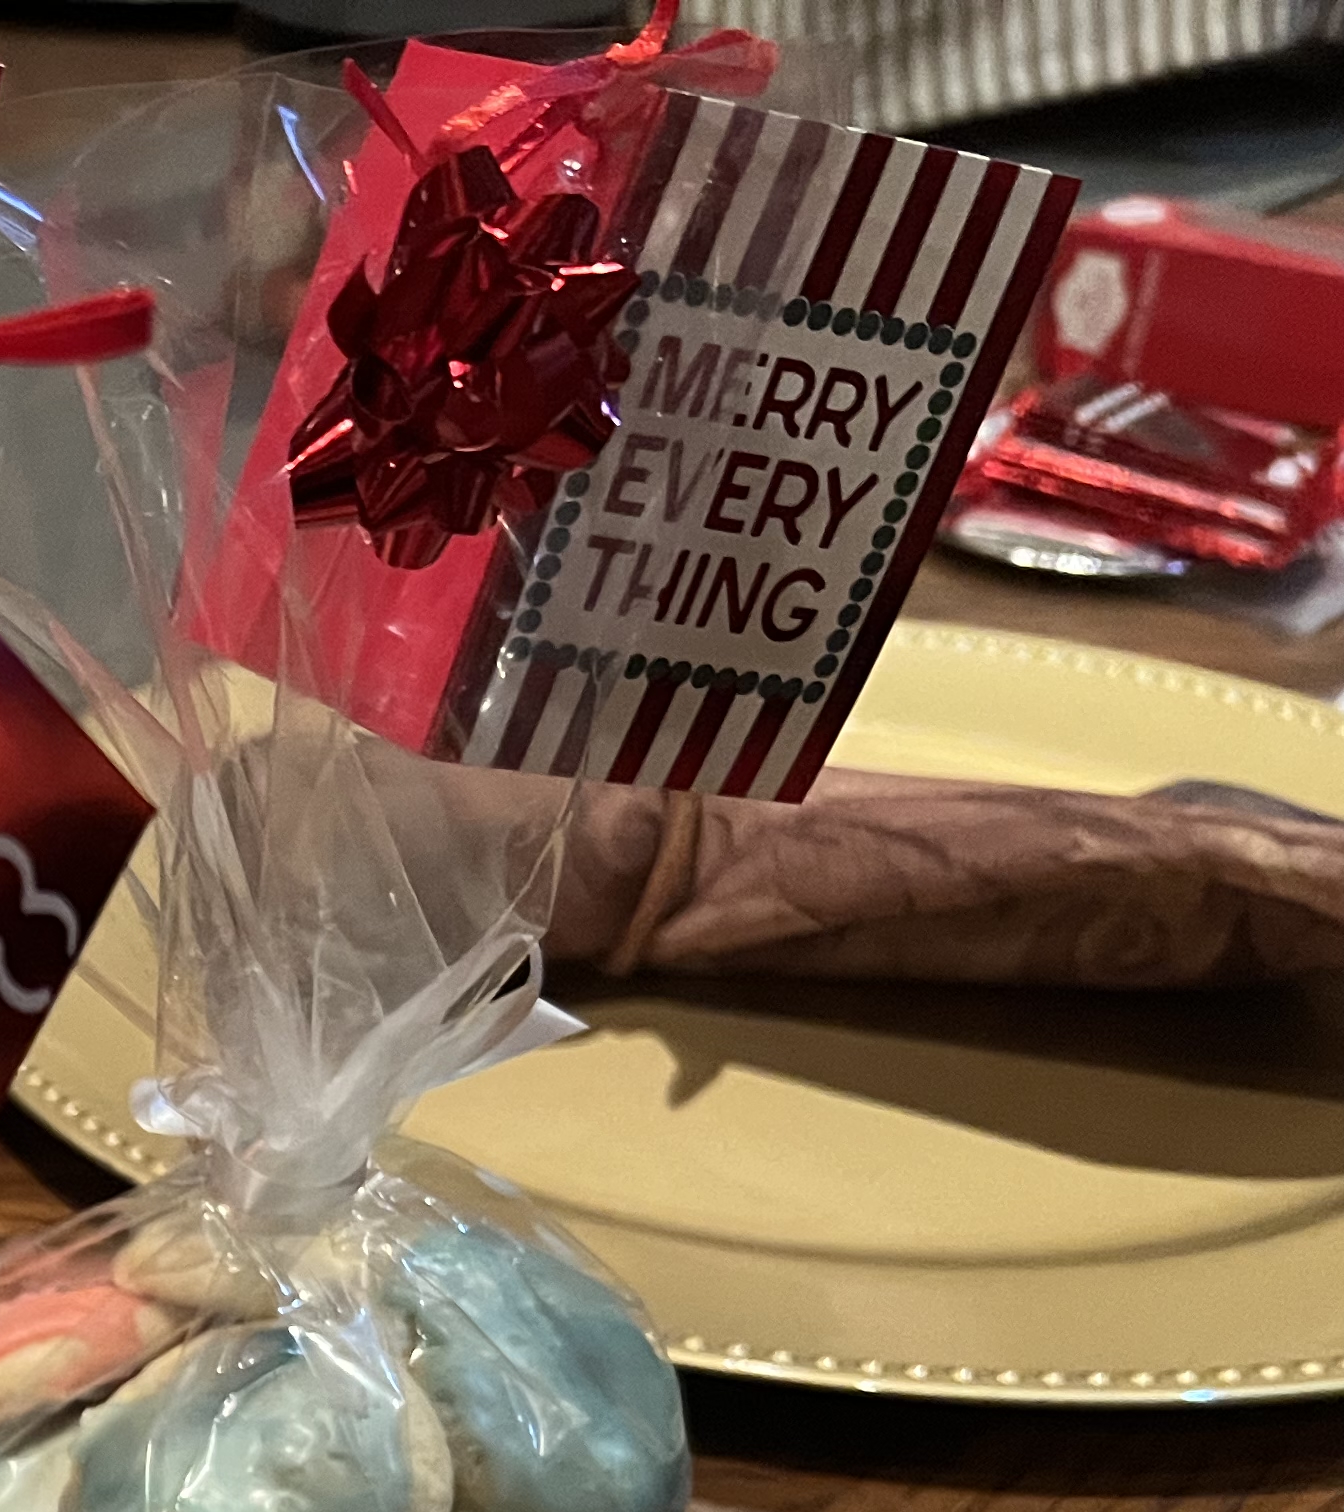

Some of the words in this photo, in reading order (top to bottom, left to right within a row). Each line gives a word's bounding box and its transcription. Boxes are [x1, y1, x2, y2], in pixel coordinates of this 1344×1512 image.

[639, 335, 924, 452] MERRY
[602, 433, 879, 550] EVERY
[581, 535, 827, 643] THING
